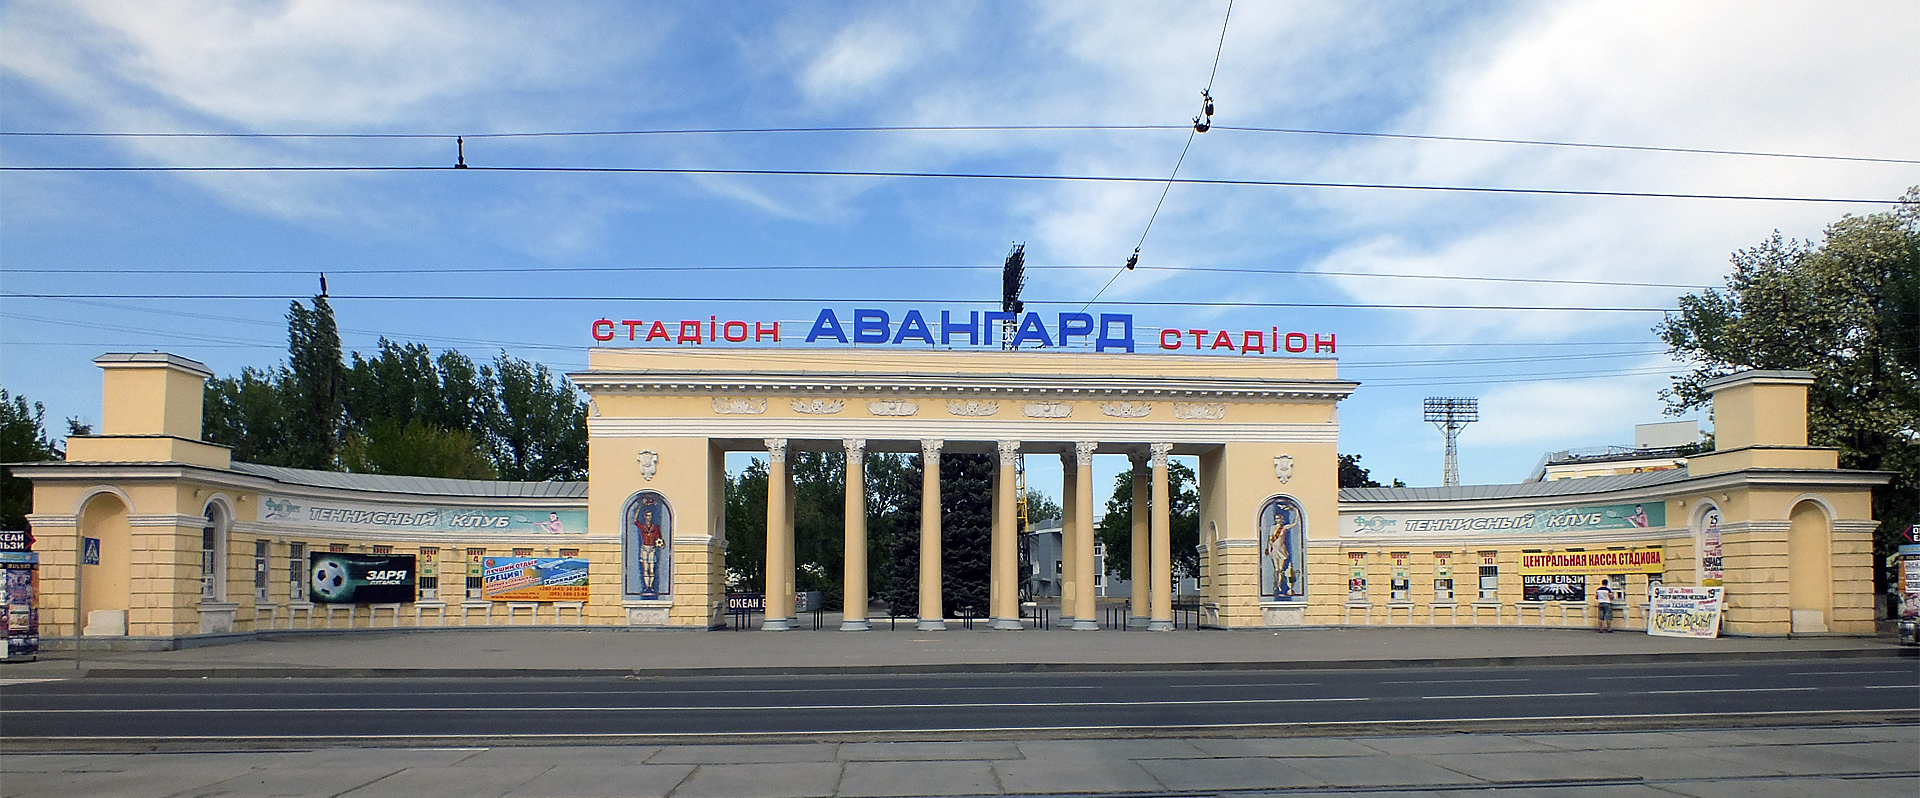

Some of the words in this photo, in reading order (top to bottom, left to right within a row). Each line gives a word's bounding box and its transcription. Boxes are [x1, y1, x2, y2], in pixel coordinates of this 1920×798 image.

[592, 315, 778, 345] СТАДІОН
[805, 308, 1134, 353] АВАНГАРД
[1160, 326, 1336, 354] СТАДІОН
[309, 506, 438, 526] ТЕННИСНЫЙ
[449, 513, 511, 528] КЛУБ
[1405, 513, 1535, 532] ТЕННИСНЫЙ
[1546, 513, 1602, 528] КЛУБ
[1522, 554, 1587, 568] ЦЕНТРАЛЬНАЯ
[1588, 553, 1617, 566] КАССА
[1618, 551, 1661, 566] СТАДИОНА
[366, 570, 407, 580] ЗАРЯ
[485, 564, 514, 575] ЛУЧШИЙ
[485, 569, 523, 583] ГРЕЦИЯ!
[1524, 575, 1552, 584] ОКЕАН
[1555, 575, 1584, 584] ЕЛЬЗИ
[729, 598, 759, 608] ОКЕАН
